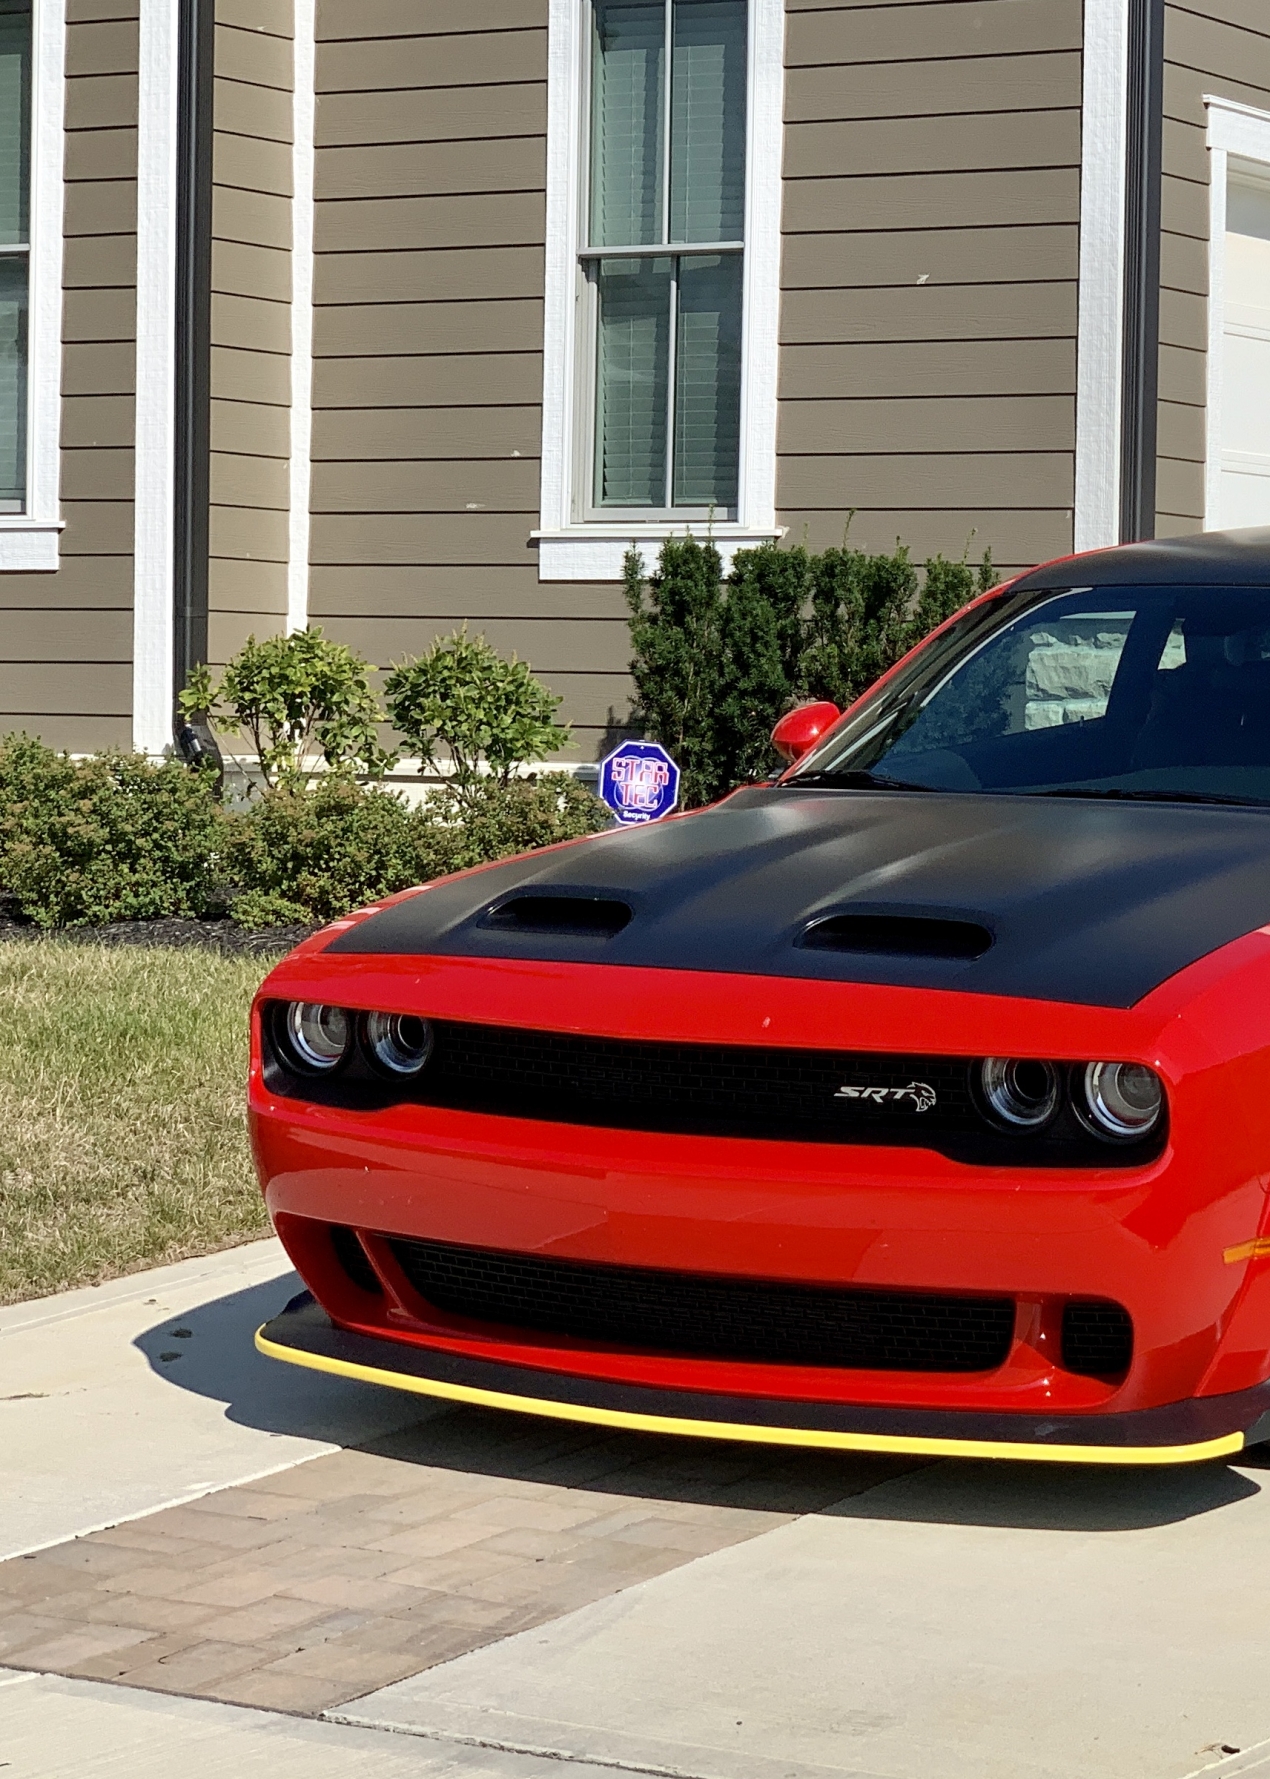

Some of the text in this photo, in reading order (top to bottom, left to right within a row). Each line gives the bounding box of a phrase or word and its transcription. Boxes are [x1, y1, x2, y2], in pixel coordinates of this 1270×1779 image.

[611, 758, 669, 785] STAR
[620, 782, 658, 808] TEC
[623, 811, 651, 820] Security
[833, 1086, 915, 1103] SRT
